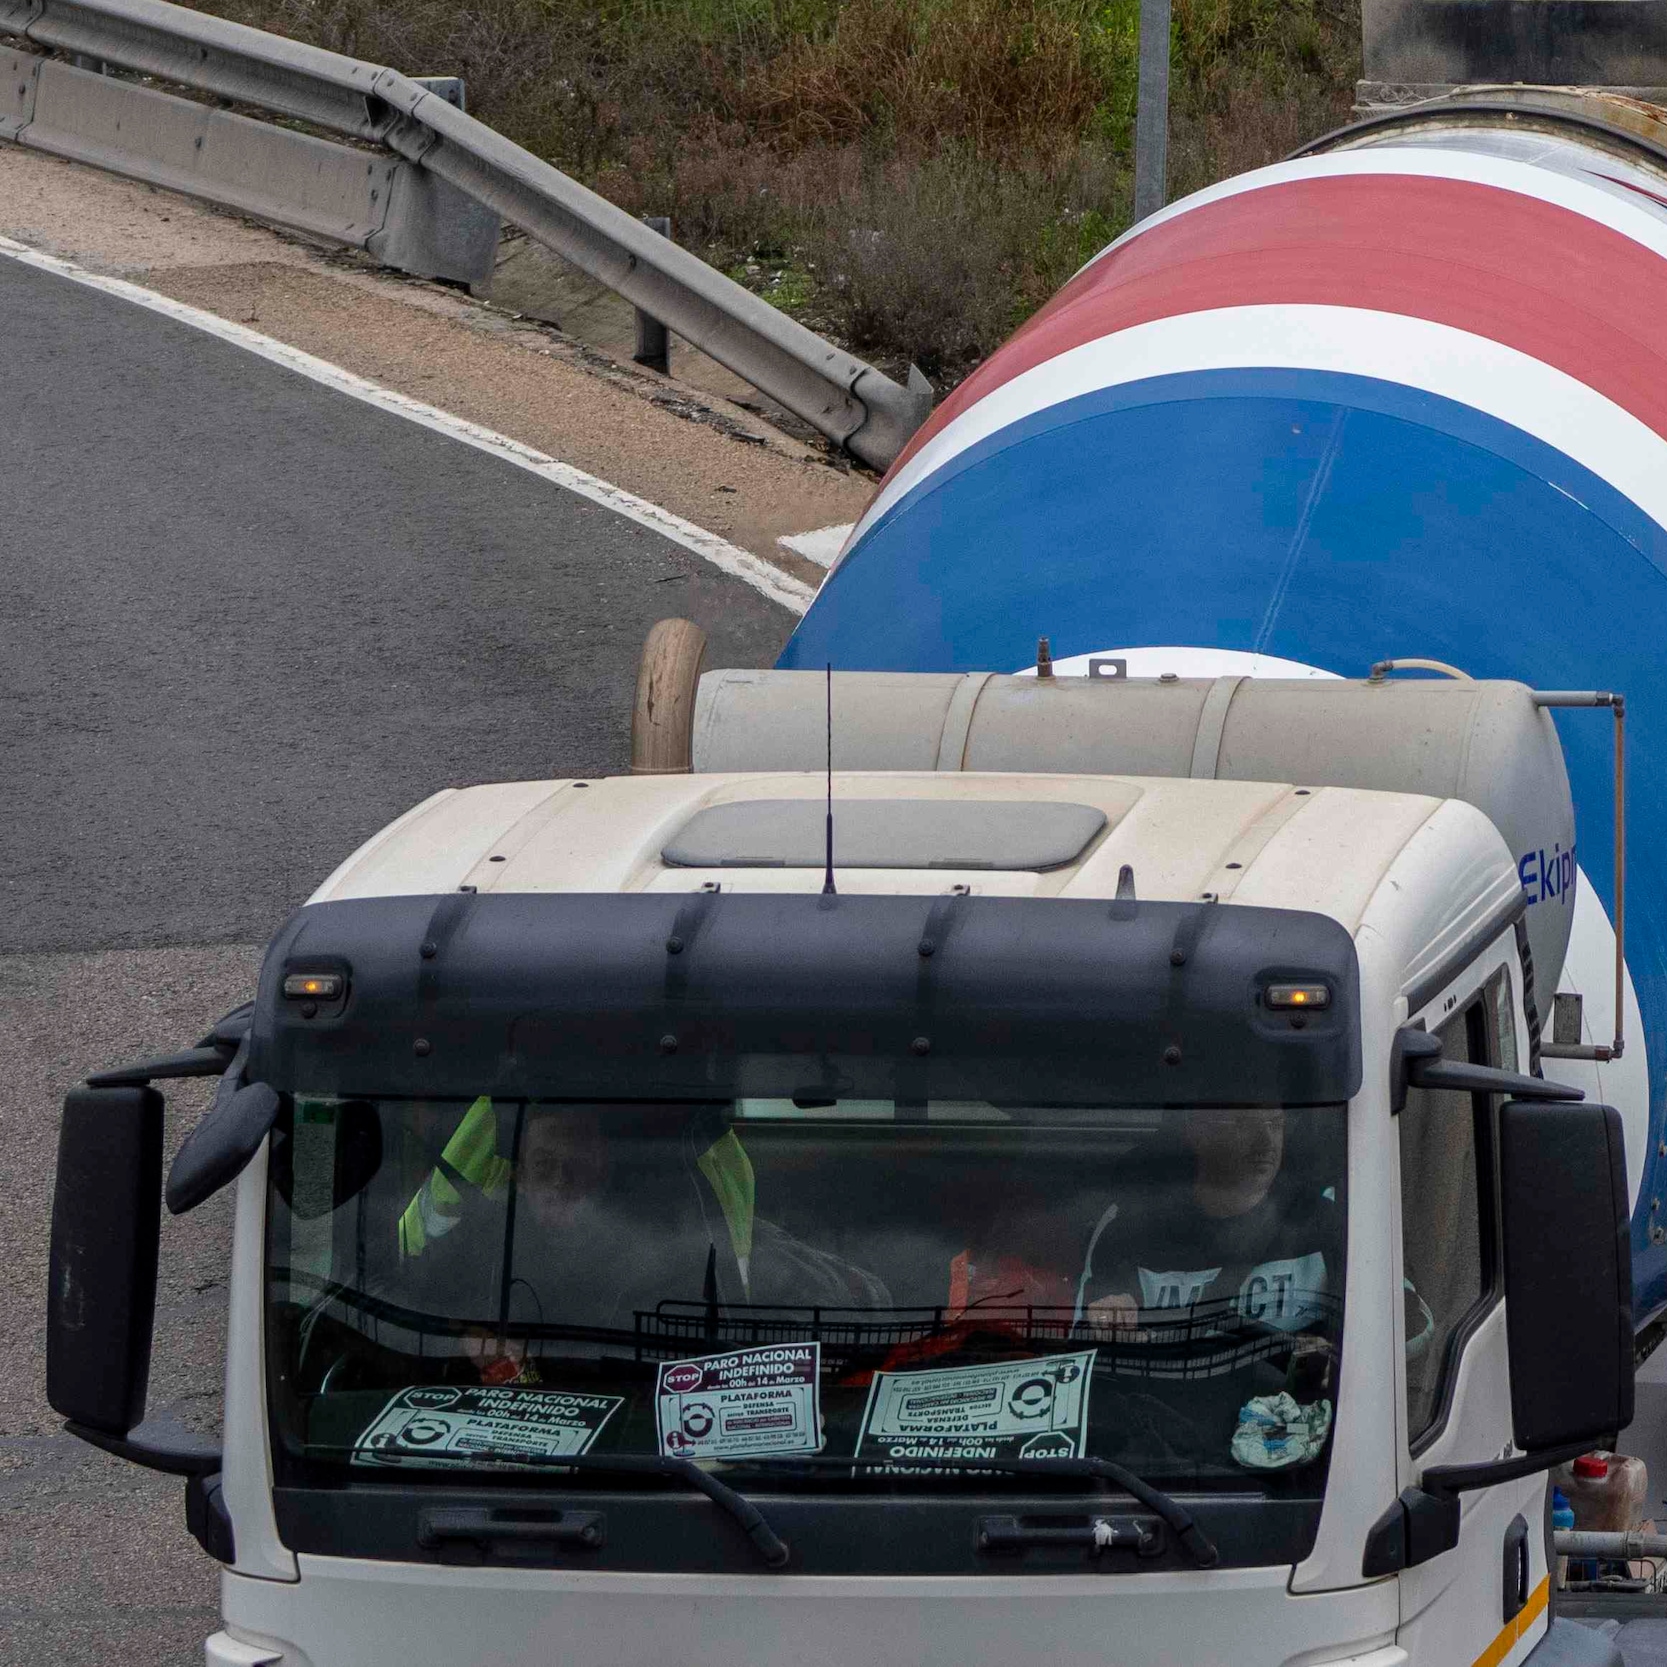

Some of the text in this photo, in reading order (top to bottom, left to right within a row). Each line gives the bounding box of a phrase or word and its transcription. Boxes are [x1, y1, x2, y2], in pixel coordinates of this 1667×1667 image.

[704, 1349, 811, 1372] PARO NACIONAL
[719, 1363, 795, 1380] INDEFINIDO
[667, 1373, 700, 1383] STOP
[729, 1379, 747, 1388] 00h
[757, 1377, 768, 1386] 14
[776, 1376, 805, 1385] Marzo
[412, 1387, 608, 1410] STOP PARO NACIONAL
[720, 1390, 793, 1403] PLATAFORMA
[478, 1398, 579, 1417] INDEFINIDO
[743, 1401, 774, 1409] DEFENSA
[486, 1408, 511, 1420] 00h
[523, 1411, 539, 1423] 14
[547, 1415, 587, 1427] Marzo
[746, 1407, 789, 1416] TRANSPORTE
[907, 1406, 965, 1418] TRANSPORTE
[926, 1414, 969, 1423] DEFENSA
[466, 1418, 561, 1437] PLATAFORMA
[899, 1420, 998, 1433] PLATAFORMA
[490, 1429, 533, 1440] DEFENSA
[877, 1436, 918, 1444] Marzo
[491, 1435, 549, 1448] TRANSPORTE
[929, 1437, 944, 1445] 14
[959, 1437, 983, 1446] 00h
[889, 1445, 1070, 1459] STOP INDEFINIDO
